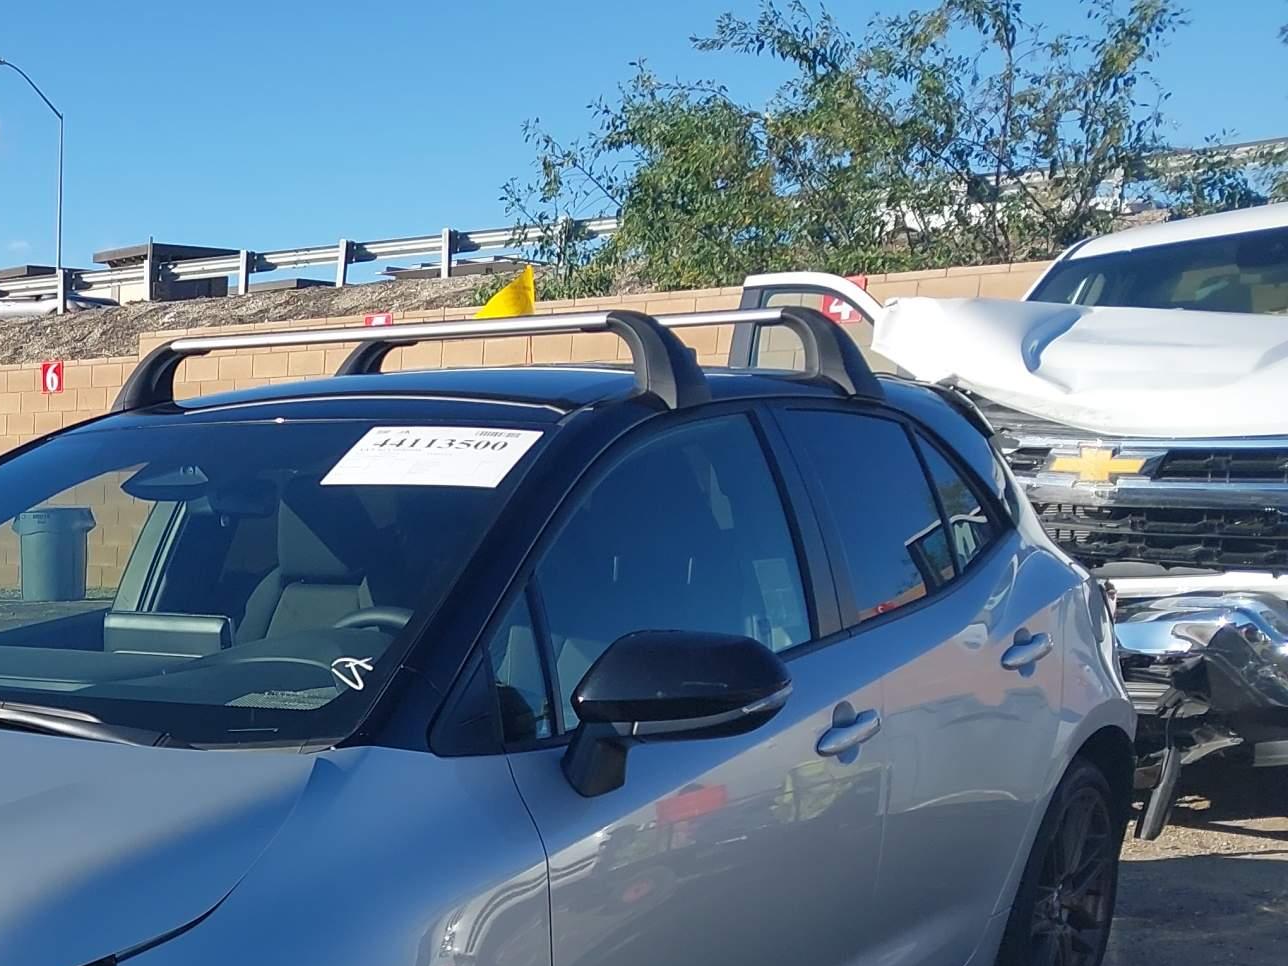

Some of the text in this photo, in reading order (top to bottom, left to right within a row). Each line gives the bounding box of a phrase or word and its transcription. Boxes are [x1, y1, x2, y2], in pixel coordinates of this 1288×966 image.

[829, 298, 853, 320] 4
[45, 363, 59, 392] 6
[373, 437, 509, 452] 44113500
